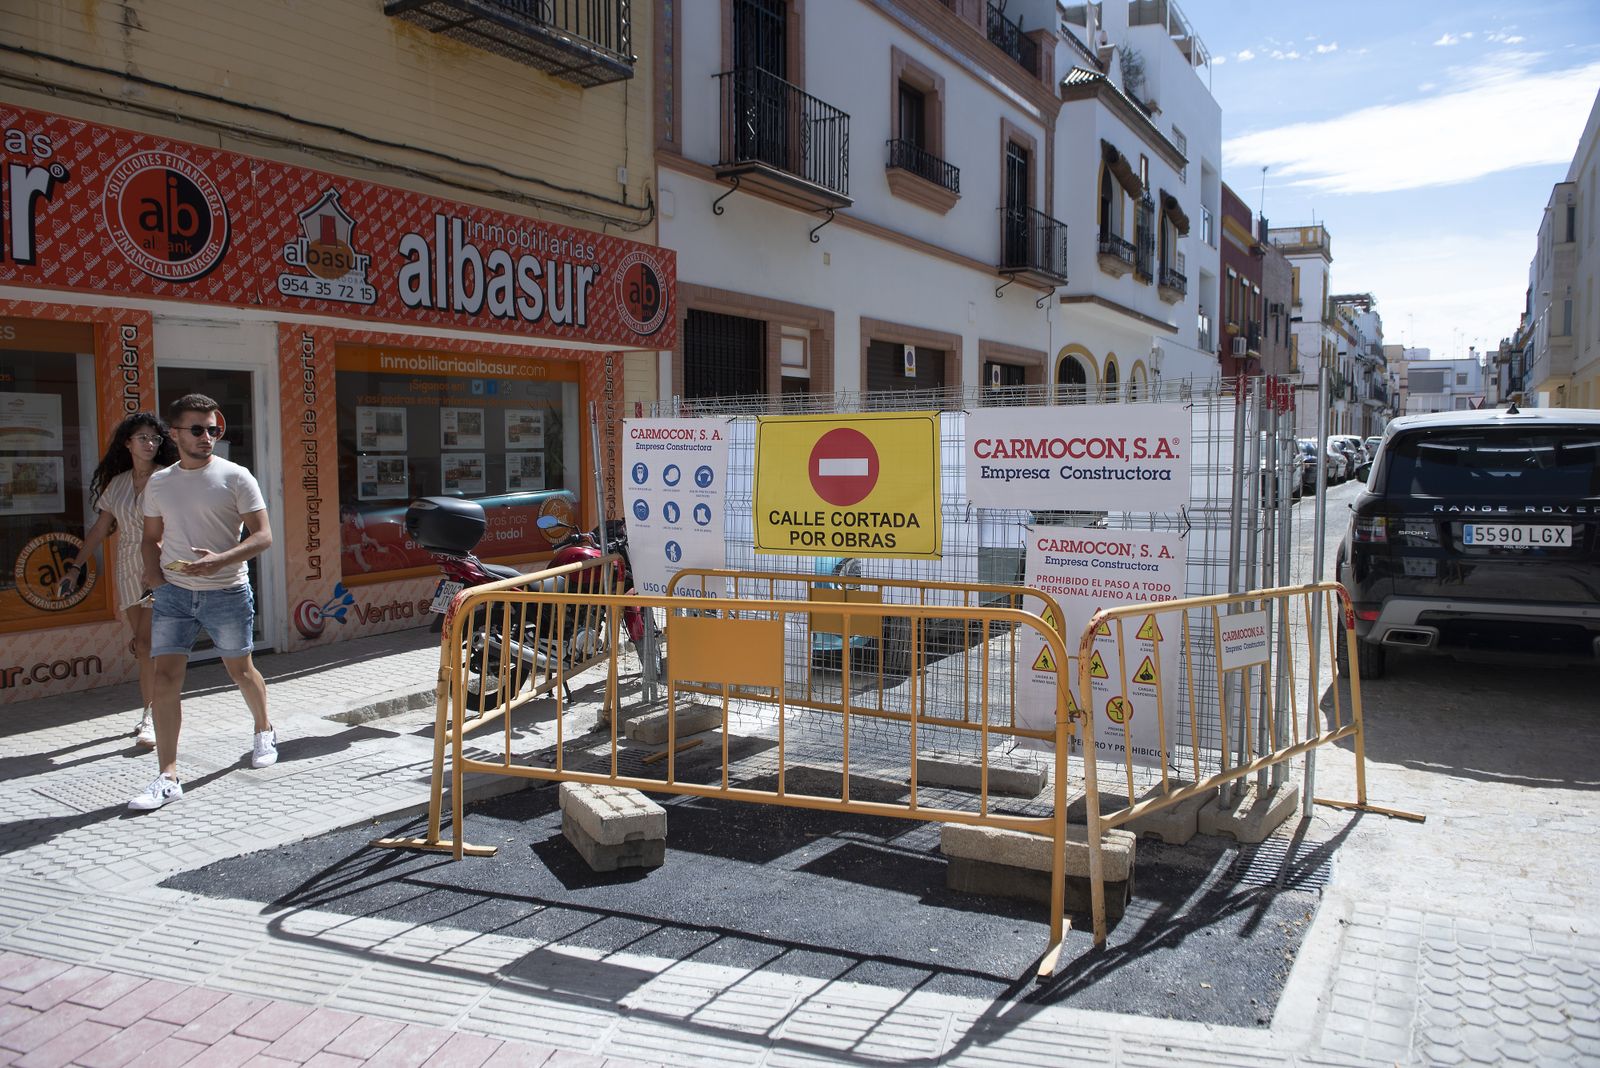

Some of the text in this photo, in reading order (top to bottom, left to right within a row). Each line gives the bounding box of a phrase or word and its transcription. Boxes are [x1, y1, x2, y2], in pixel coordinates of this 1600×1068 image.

[107, 154, 222, 216] SOLUCIONES FINANCIERAS
[465, 216, 596, 261] inmobiliarias
[113, 230, 220, 277] FINANCIAL MANAGER
[285, 239, 368, 271] albasur
[281, 277, 372, 300] 954 35 72 15
[118, 323, 141, 416] anciera
[380, 352, 546, 377] inmobiliariaalbasur.com
[630, 428, 723, 442] CARMOCON, S. A.
[635, 442, 712, 452] Empresa Constructora
[300, 332, 322, 582] La tranquilidad de acertar
[605, 440, 616, 521] Soluciones
[981, 465, 1171, 482] Empresa Constructora
[1433, 504, 1508, 513] RANGE
[768, 510, 921, 528] CALLE CORTADA
[790, 531, 897, 548] POR OBRAS
[1475, 526, 1565, 544] 5590 LGX
[1037, 538, 1175, 559] CARMOCON, S. A.
[1044, 556, 1159, 572] Empresa Constructora
[643, 582, 660, 593] USO
[1036, 574, 1089, 587] PROHIBIDO
[1092, 578, 1102, 587] EL
[1105, 579, 1131, 590] PASO
[1132, 581, 1140, 590] A
[1142, 582, 1171, 592] TODO
[26, 592, 69, 609] FINANCIAL
[1040, 585, 1089, 597] PERSONAL
[1091, 589, 1123, 599] AJENO
[1125, 592, 1133, 600] A
[1135, 592, 1147, 602] LA
[353, 599, 413, 626] Venta
